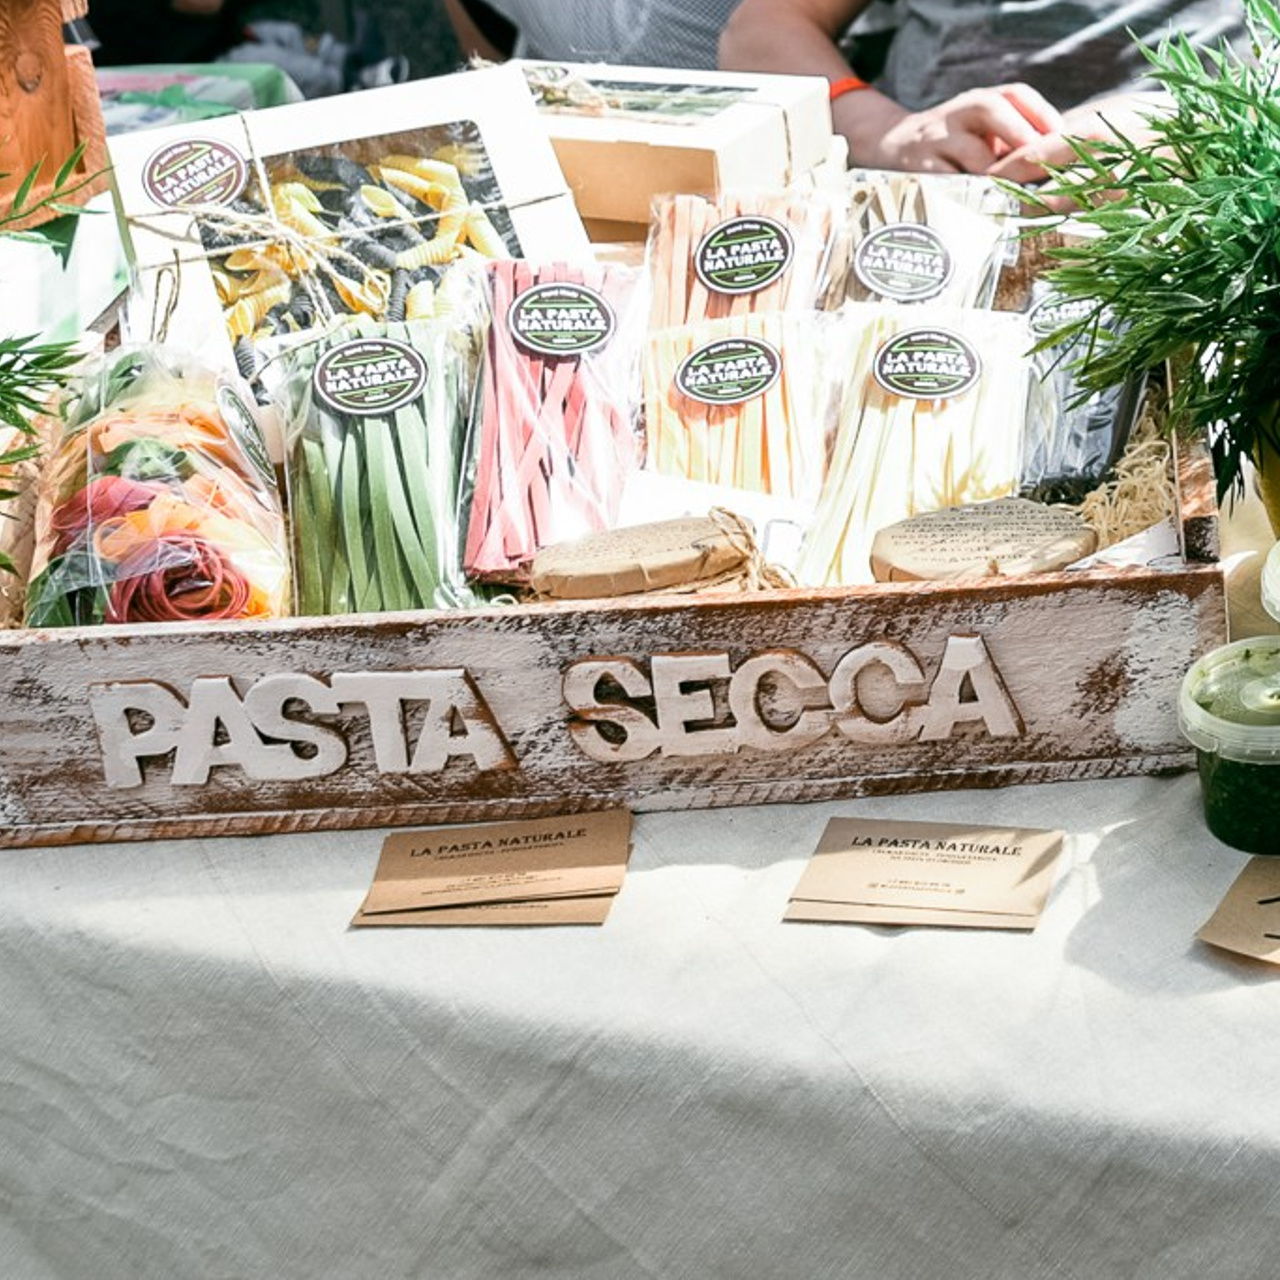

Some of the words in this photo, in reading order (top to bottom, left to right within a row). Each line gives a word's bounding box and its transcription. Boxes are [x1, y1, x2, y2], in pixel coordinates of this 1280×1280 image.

[155, 177, 179, 192] LA
[177, 149, 225, 180] PASTA
[706, 247, 727, 259] LA
[730, 238, 781, 255] PASTA
[704, 249, 785, 272] NATURALE
[520, 309, 542, 319] LA
[547, 309, 603, 319] PASTA
[518, 319, 607, 331] NATURALE
[325, 368, 349, 381] LA
[353, 358, 412, 377] PASTA
[688, 365, 710, 376] LA
[714, 356, 768, 372] PASTA
[887, 352, 908, 363] LA
[913, 352, 969, 366] PASTA
[325, 368, 419, 393] NATURALE
[883, 363, 971, 377] NATURALE
[90, 667, 515, 790] PASTA
[562, 633, 1022, 763] SECCA
[410, 848, 431, 857] LA
[438, 841, 493, 854] PASTA
[498, 829, 588, 847] NATURALE
[852, 836, 873, 846] LA
[878, 837, 931, 849] PASTA
[935, 839, 1022, 857] NATURALE
